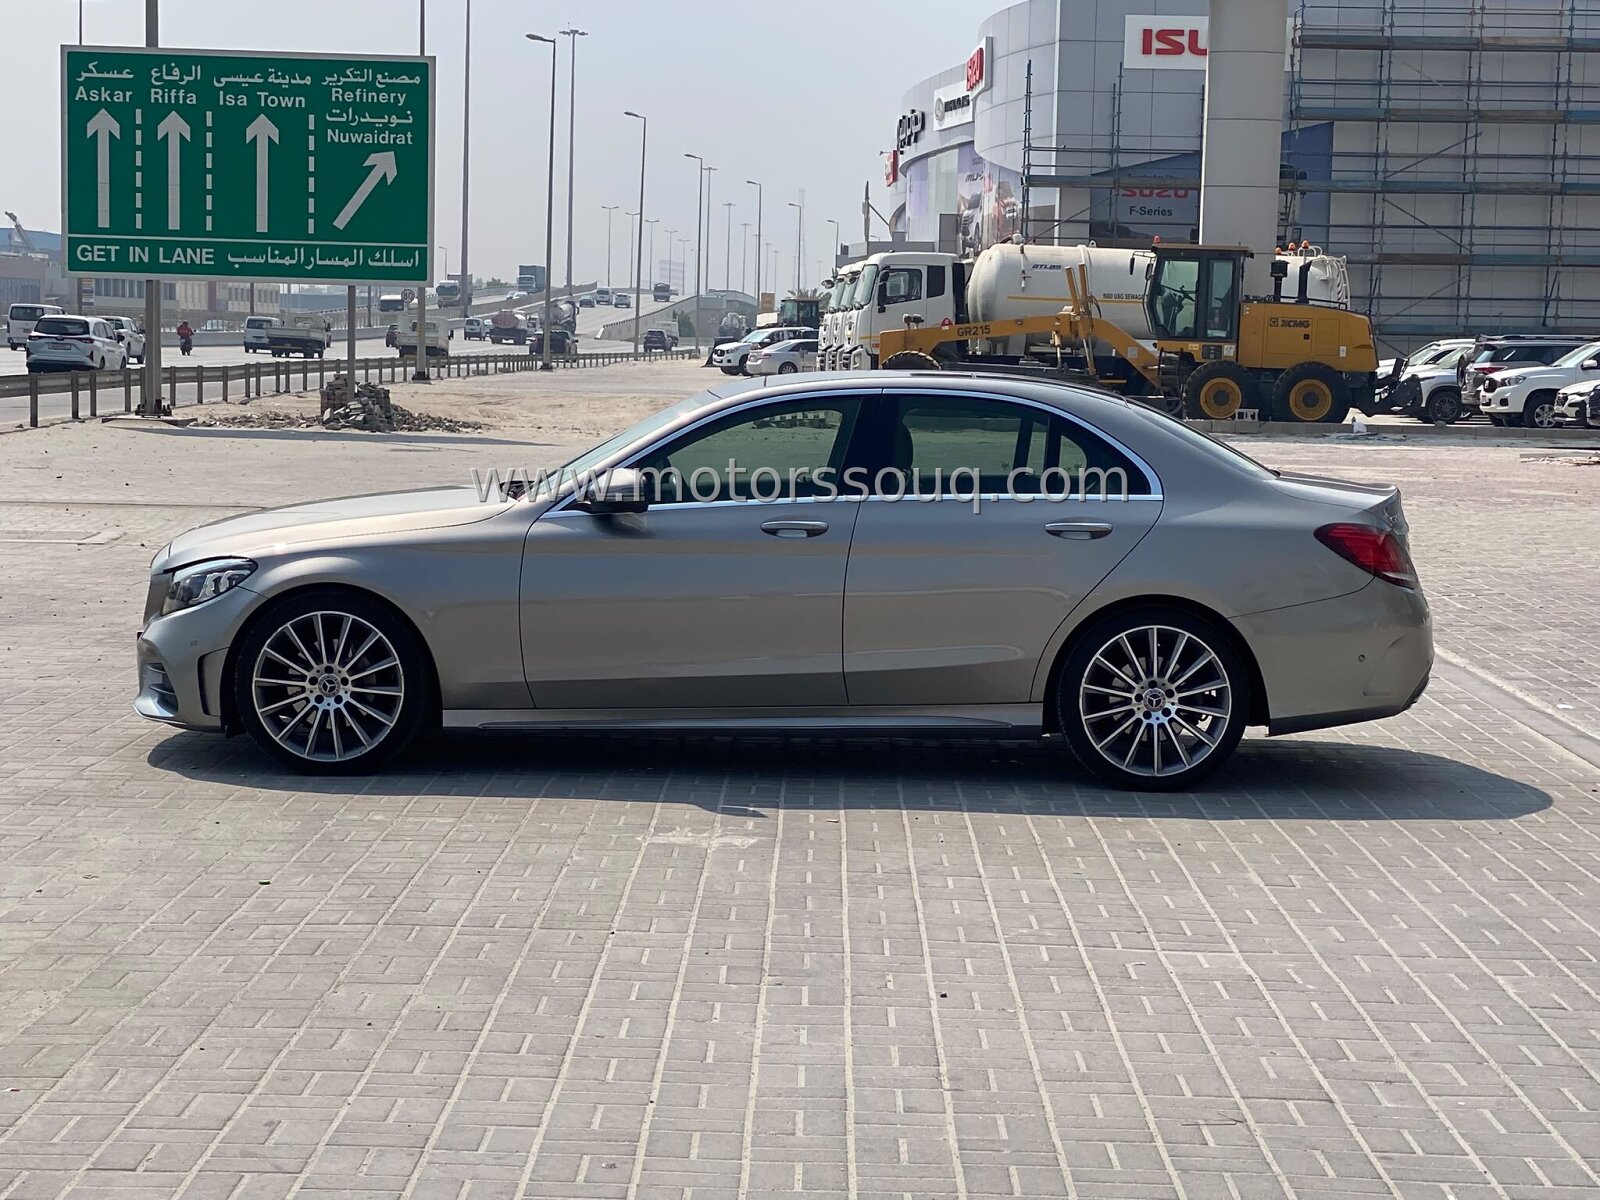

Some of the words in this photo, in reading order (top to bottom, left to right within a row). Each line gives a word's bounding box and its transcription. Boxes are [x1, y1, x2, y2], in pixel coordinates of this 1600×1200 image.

[76, 61, 135, 81] عسكر
[150, 62, 201, 86] الرفاع
[213, 72, 265, 88] عيسى
[267, 68, 312, 88] مدينة
[321, 68, 373, 86] التكرير
[375, 71, 421, 88] مصنع
[75, 86, 133, 103] Askar
[150, 88, 197, 105] Riffa
[219, 91, 248, 107] Isa
[257, 91, 306, 109] Town
[331, 88, 406, 106] Refinery
[325, 107, 413, 127] نويدرات
[327, 129, 413, 145] Nuwaidrat
[1129, 205, 1173, 216] F-Series
[76, 244, 120, 262] GET
[128, 246, 149, 263] IN
[158, 248, 215, 265] LANE
[227, 246, 304, 269] المناسب
[304, 247, 363, 270] المسار
[367, 249, 419, 268] اسلك
[957, 325, 991, 336] GR215
